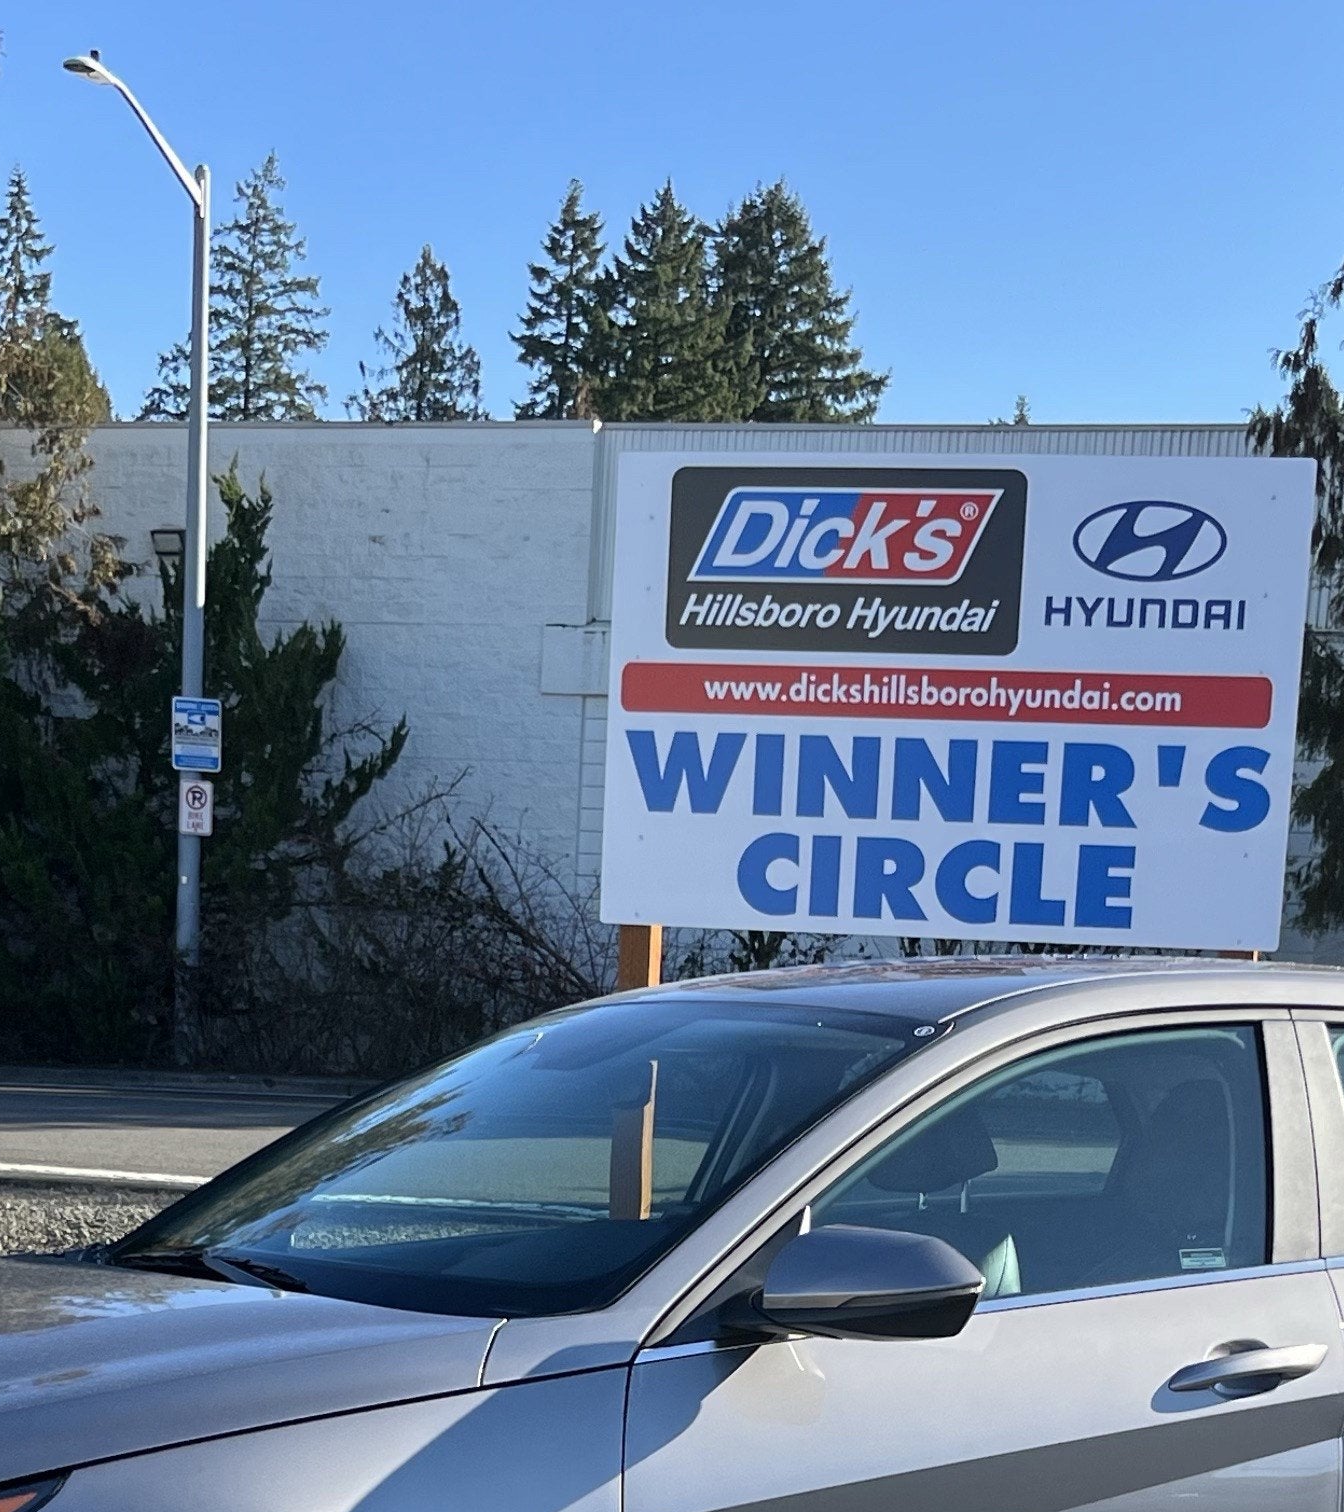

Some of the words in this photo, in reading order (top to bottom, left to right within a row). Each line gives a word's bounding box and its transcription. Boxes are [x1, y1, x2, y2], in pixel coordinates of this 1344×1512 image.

[712, 498, 962, 571] Dick's
[679, 593, 841, 630] Hillsboro
[846, 597, 1000, 638] Hyundai
[1044, 595, 1247, 630] HYUNDAI
[703, 673, 1182, 717] www.dickshillsborohyundai.com
[626, 729, 1272, 833] WINNER'S
[736, 832, 1136, 930] CIRCLE
